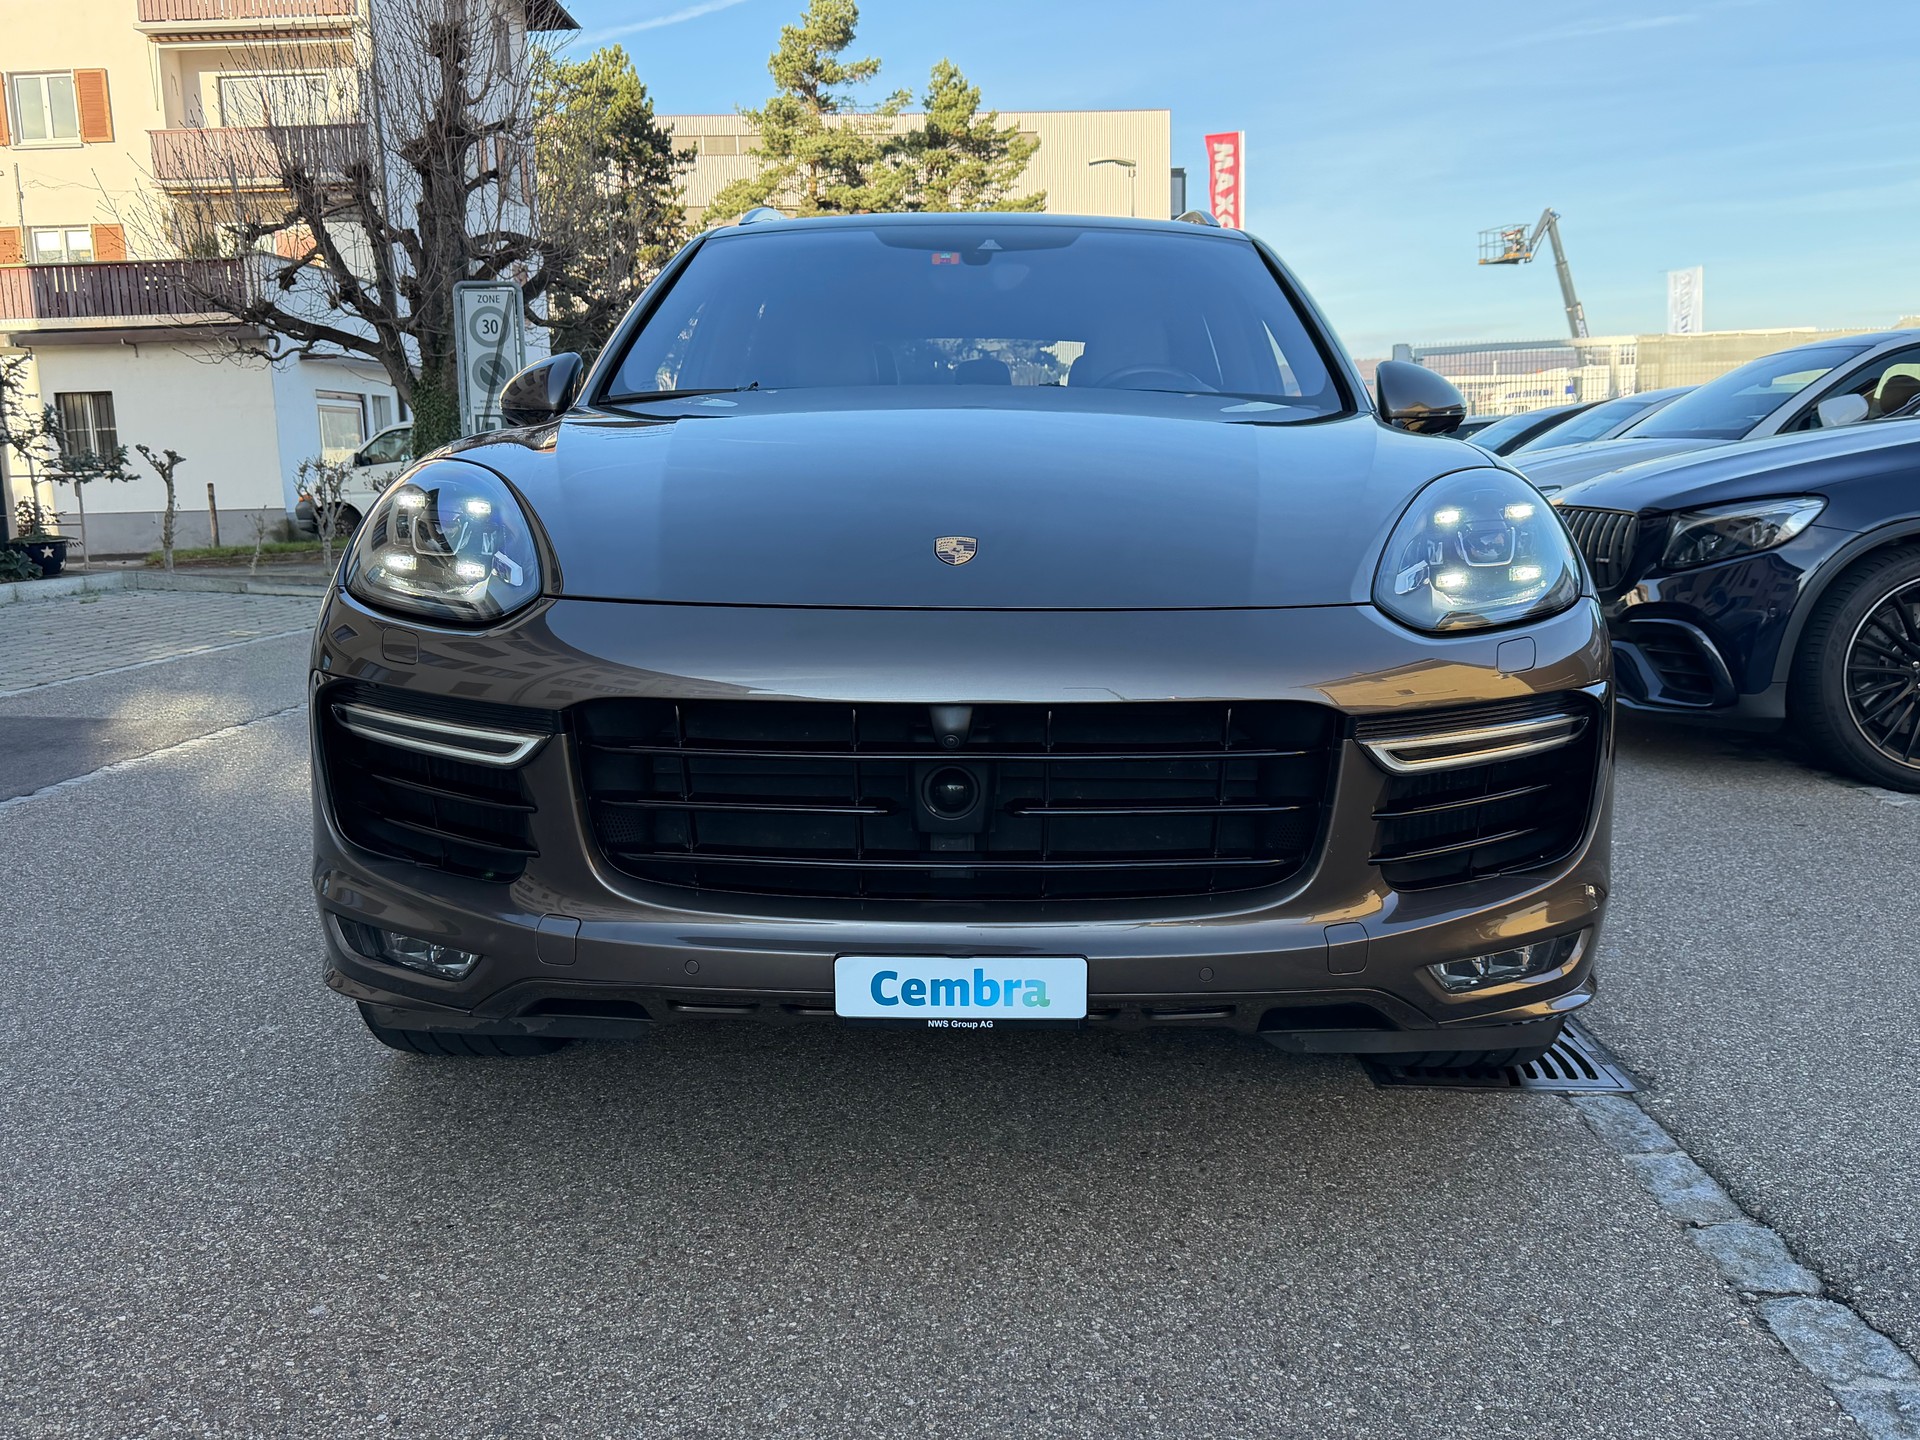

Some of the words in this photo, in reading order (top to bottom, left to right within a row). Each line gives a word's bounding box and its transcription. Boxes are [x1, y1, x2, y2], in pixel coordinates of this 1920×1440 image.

[477, 294, 501, 304] ZONE
[482, 319, 499, 335] 30
[870, 968, 1051, 1007] Cembra
[927, 1019, 949, 1028] NWS
[951, 1020, 978, 1030] Group
[979, 1020, 994, 1028] AG
